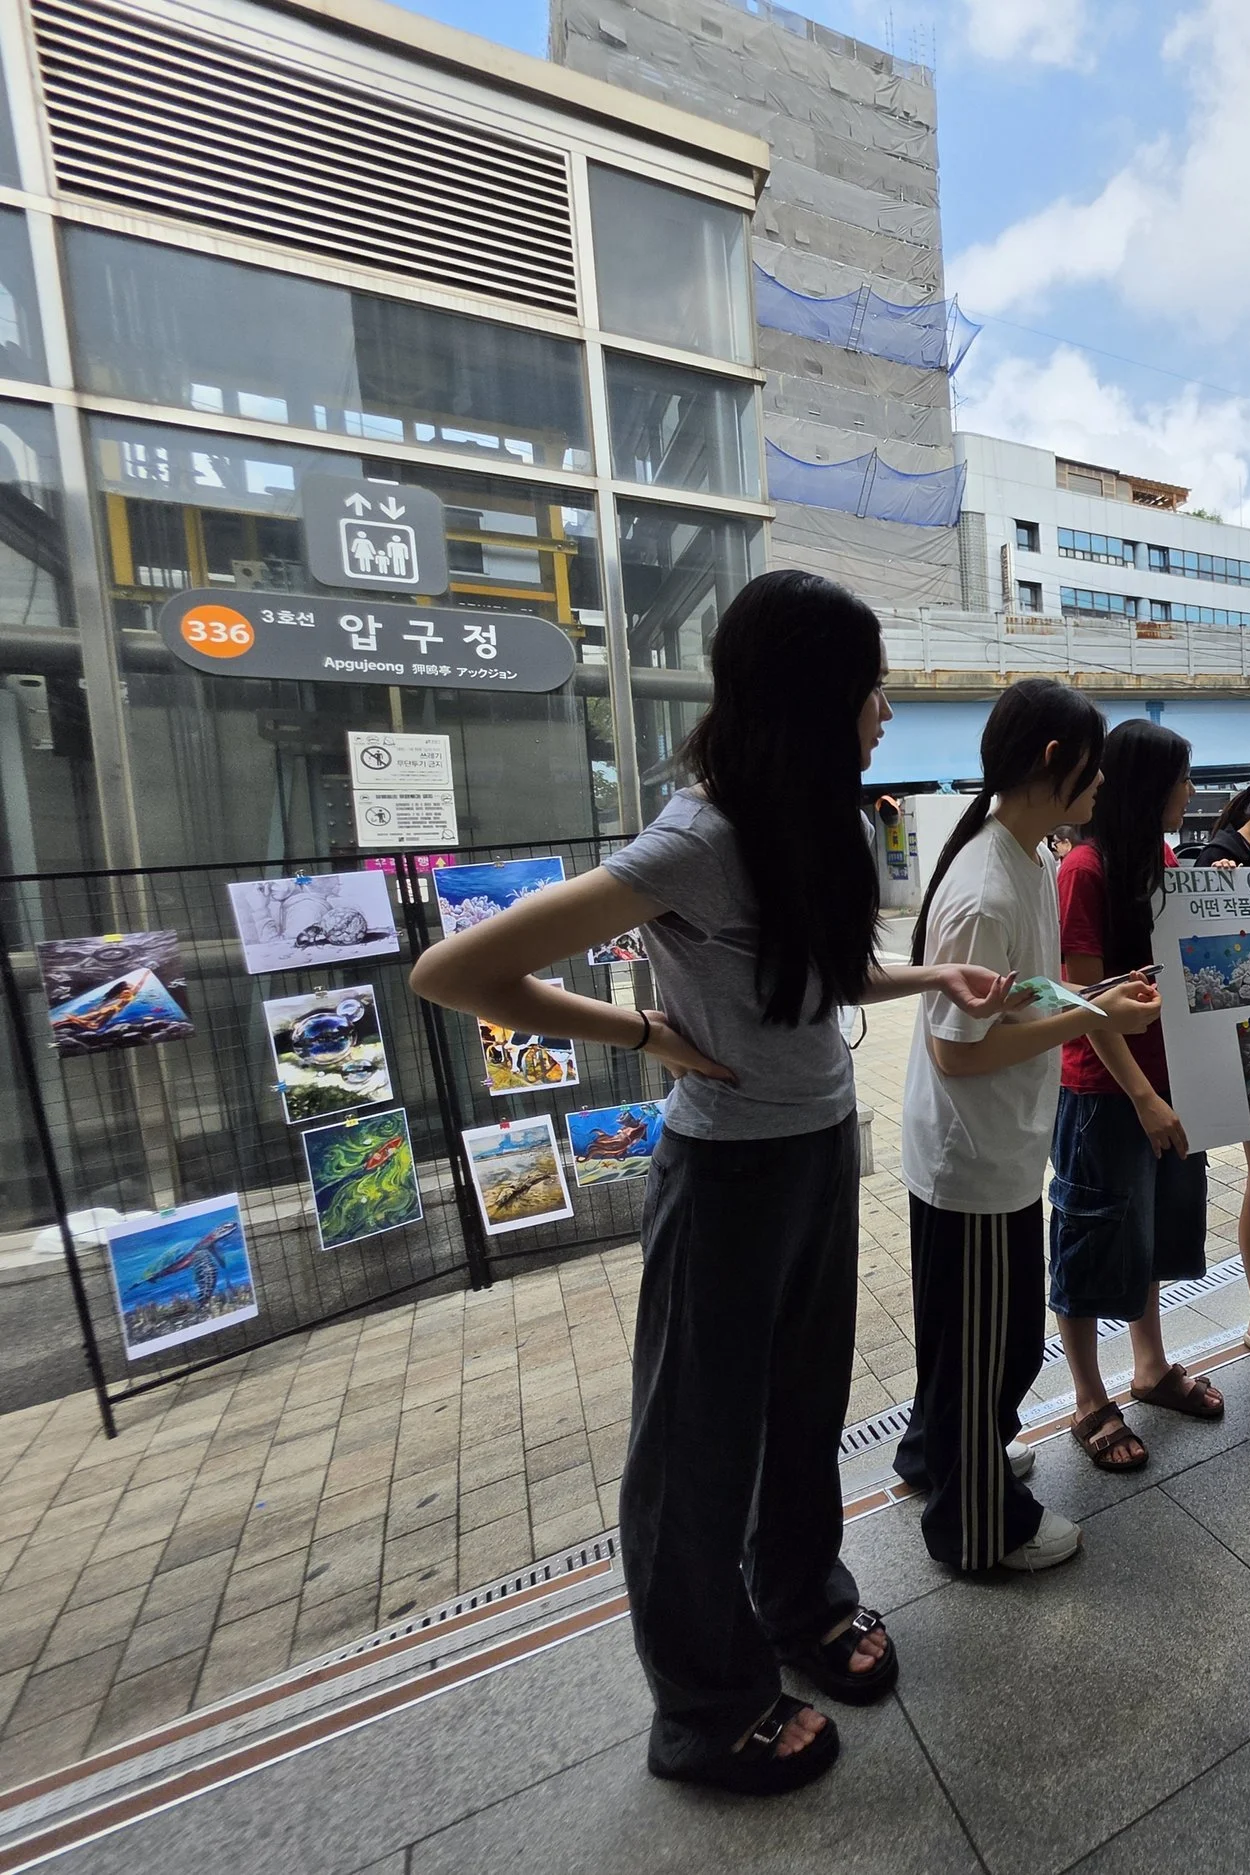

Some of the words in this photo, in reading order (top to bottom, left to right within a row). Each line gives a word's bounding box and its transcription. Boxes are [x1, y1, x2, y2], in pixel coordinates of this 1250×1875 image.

[261, 609, 316, 628] 3호선
[187, 619, 250, 645] 336
[339, 613, 498, 660] 압구정
[324, 656, 404, 675] Apgujeong
[456, 667, 518, 680] アックジョン
[420, 752, 443, 760] 쓰레기
[1163, 870, 1235, 894] GREEN
[1190, 898, 1220, 918] 어떤
